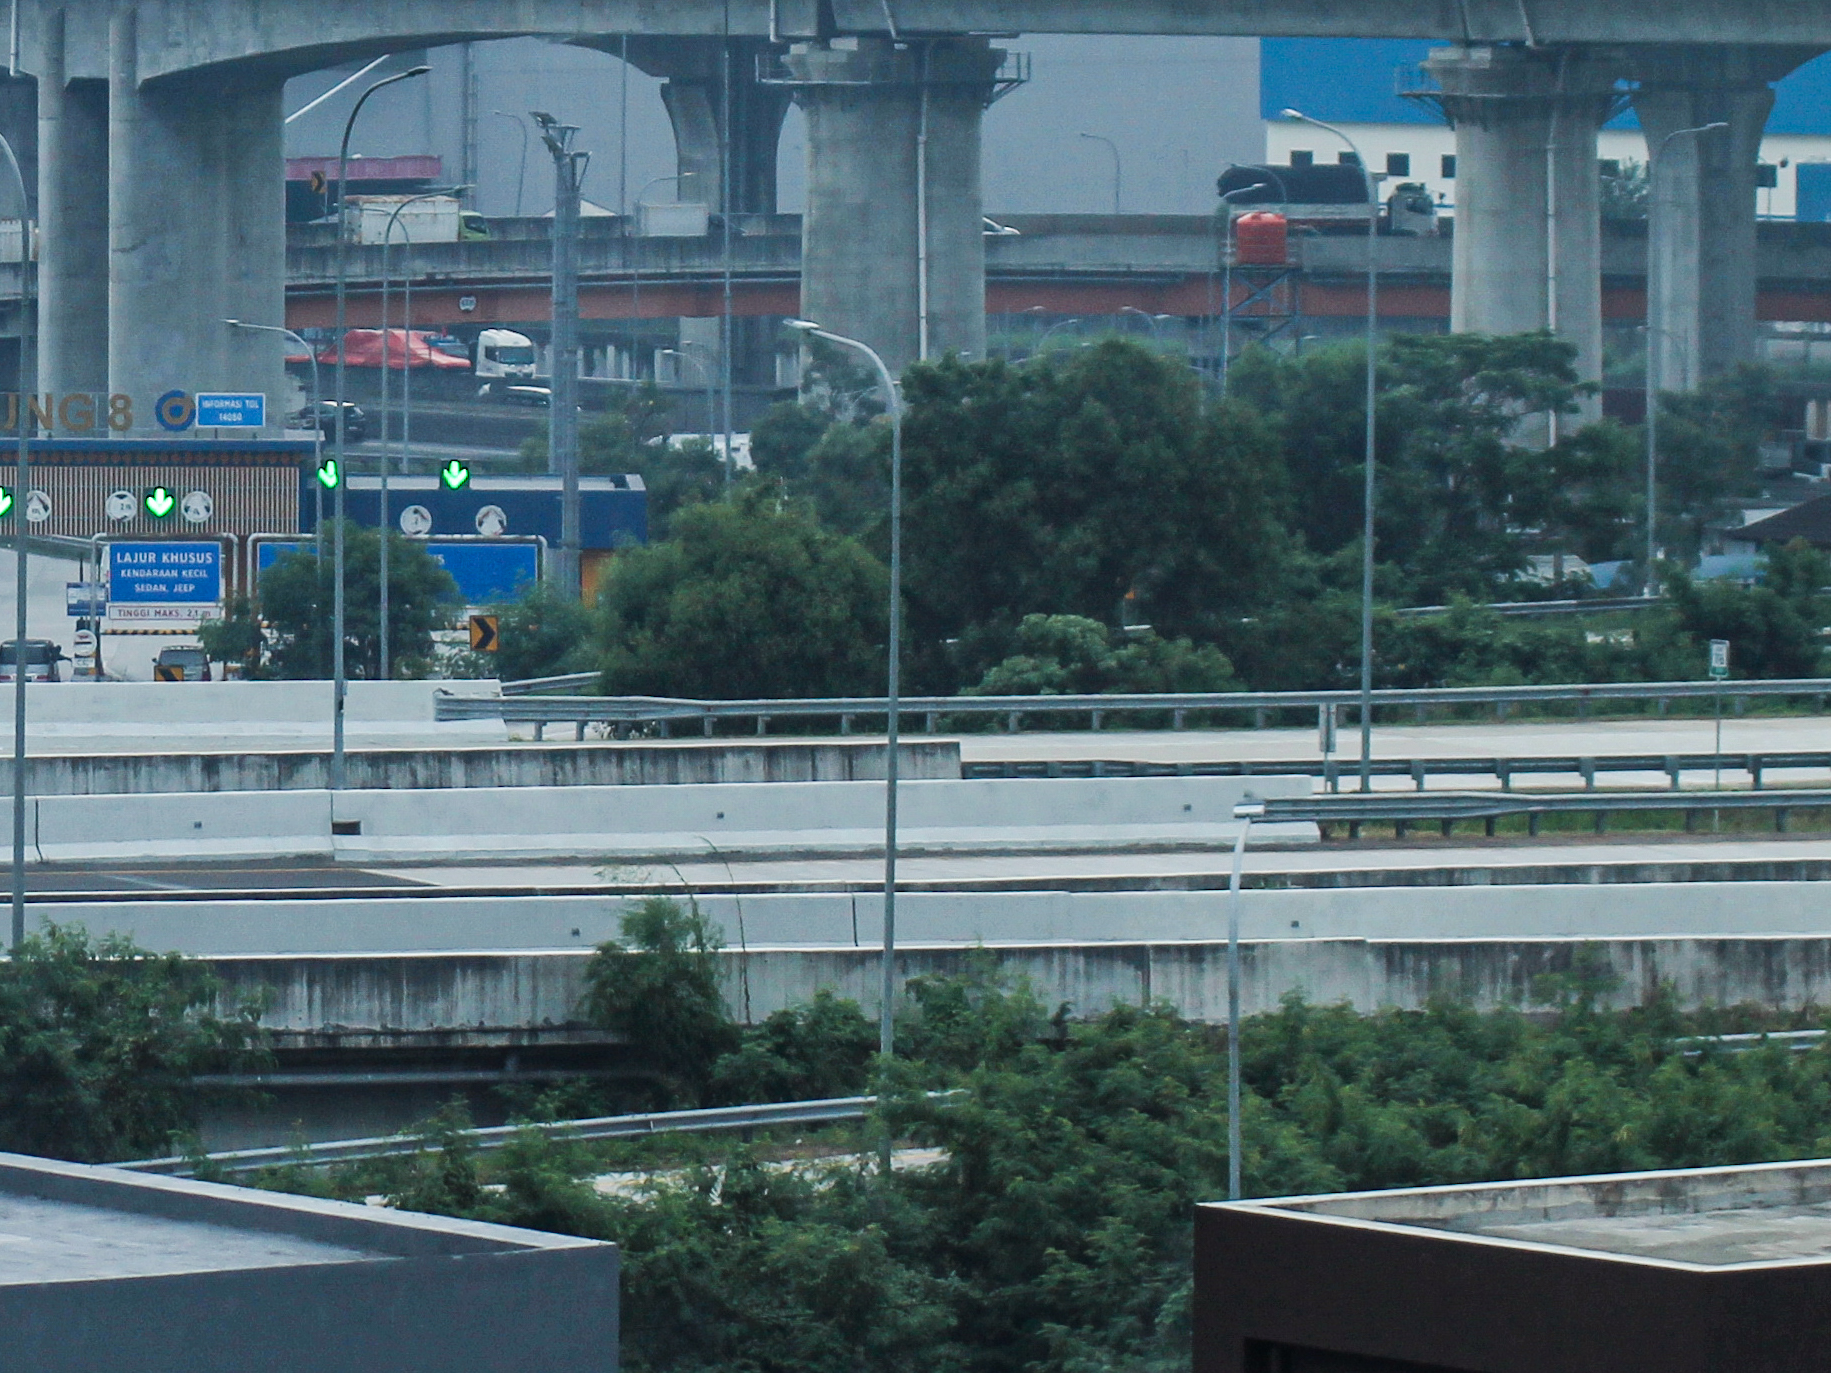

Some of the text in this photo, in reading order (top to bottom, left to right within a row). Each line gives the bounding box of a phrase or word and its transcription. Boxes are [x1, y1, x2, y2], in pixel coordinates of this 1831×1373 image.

[202, 399, 260, 408] INFORMASI TOL
[108, 393, 134, 431] 8
[116, 552, 213, 564] LAJUR KHUSUS
[121, 569, 208, 578] KENDARAAN KECIL
[173, 583, 195, 593] JEEP
[117, 609, 150, 617] TINGGI
